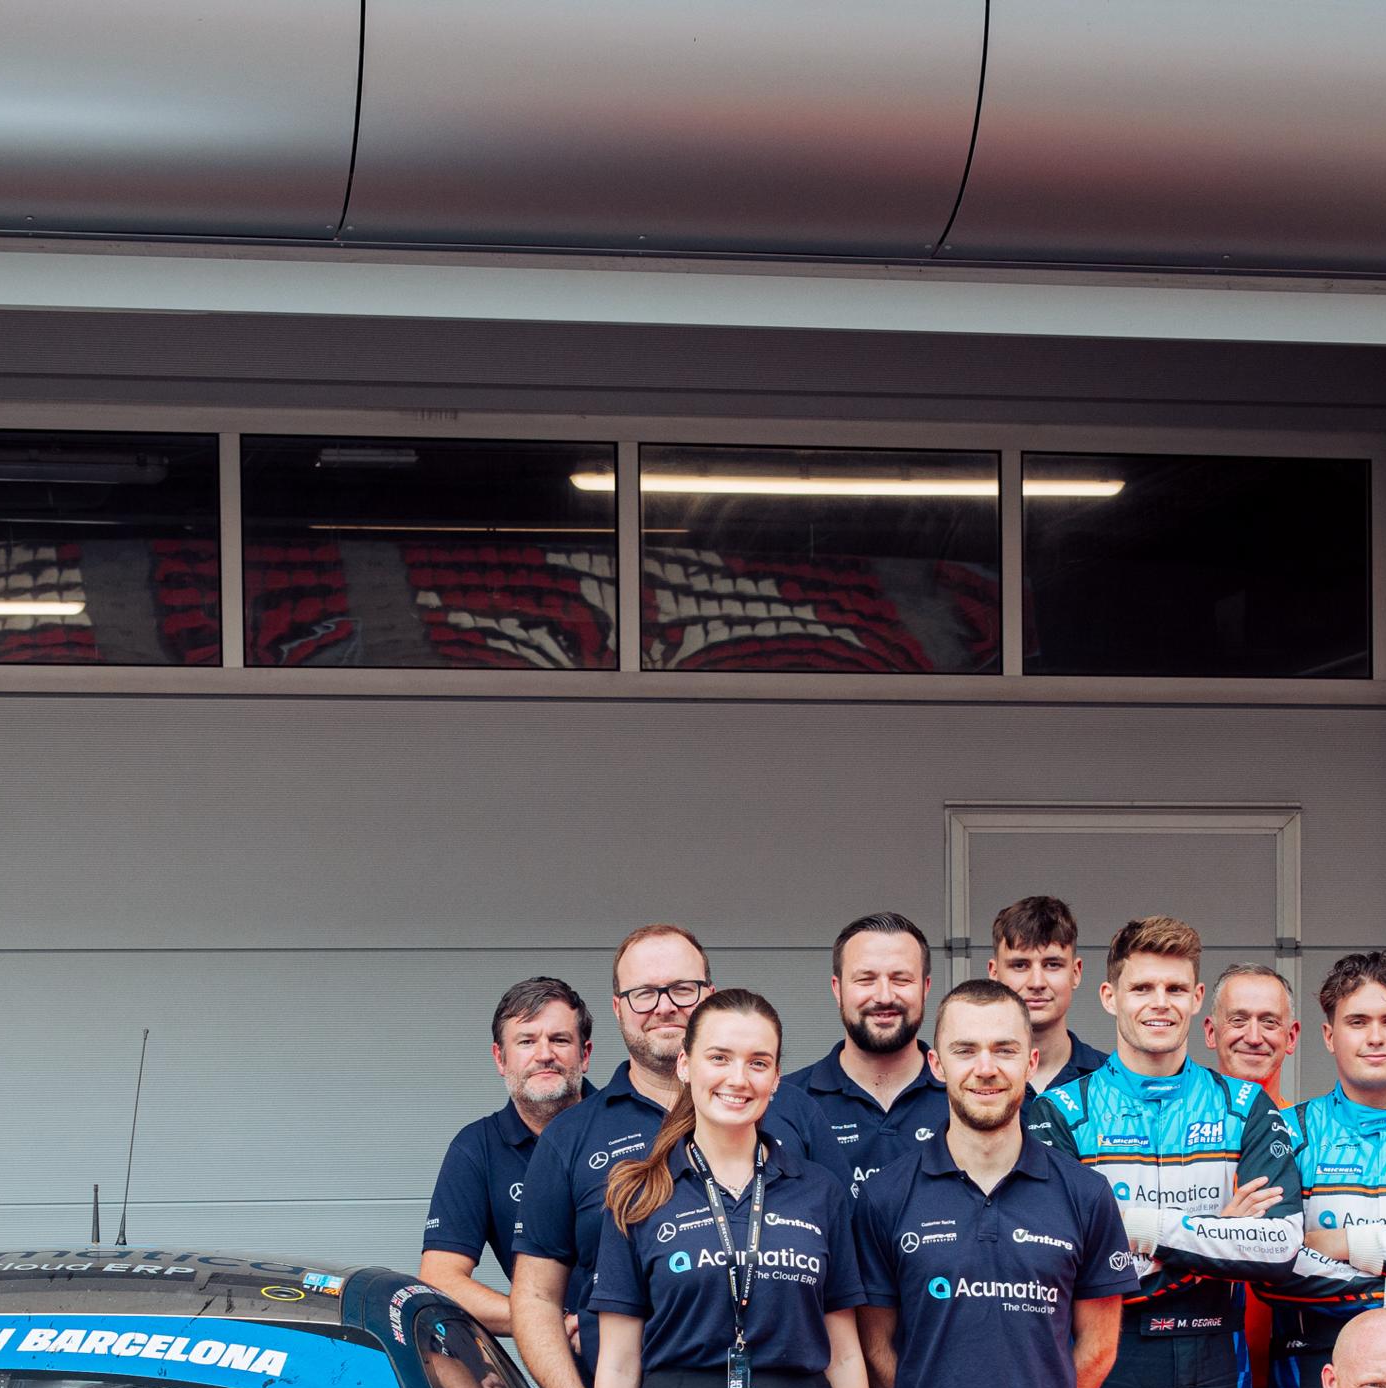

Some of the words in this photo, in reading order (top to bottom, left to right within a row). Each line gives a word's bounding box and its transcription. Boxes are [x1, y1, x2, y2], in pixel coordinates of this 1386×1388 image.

[1188, 1121, 1224, 1138] 24H
[1187, 1136, 1223, 1146] SERIES
[765, 1213, 822, 1236] Venture
[1013, 1228, 1073, 1251] Venture
[1196, 1224, 1287, 1243] Acumatica
[102, 1262, 196, 1275] ERP
[772, 1271, 799, 1283] Cloud
[800, 1274, 817, 1286] ERP
[954, 1277, 1058, 1303] Acumatica
[1002, 1302, 1020, 1312] The
[1021, 1303, 1046, 1314] Cloud
[1192, 1317, 1223, 1328] GEORGE
[17, 1328, 289, 1377] BARCELONA
